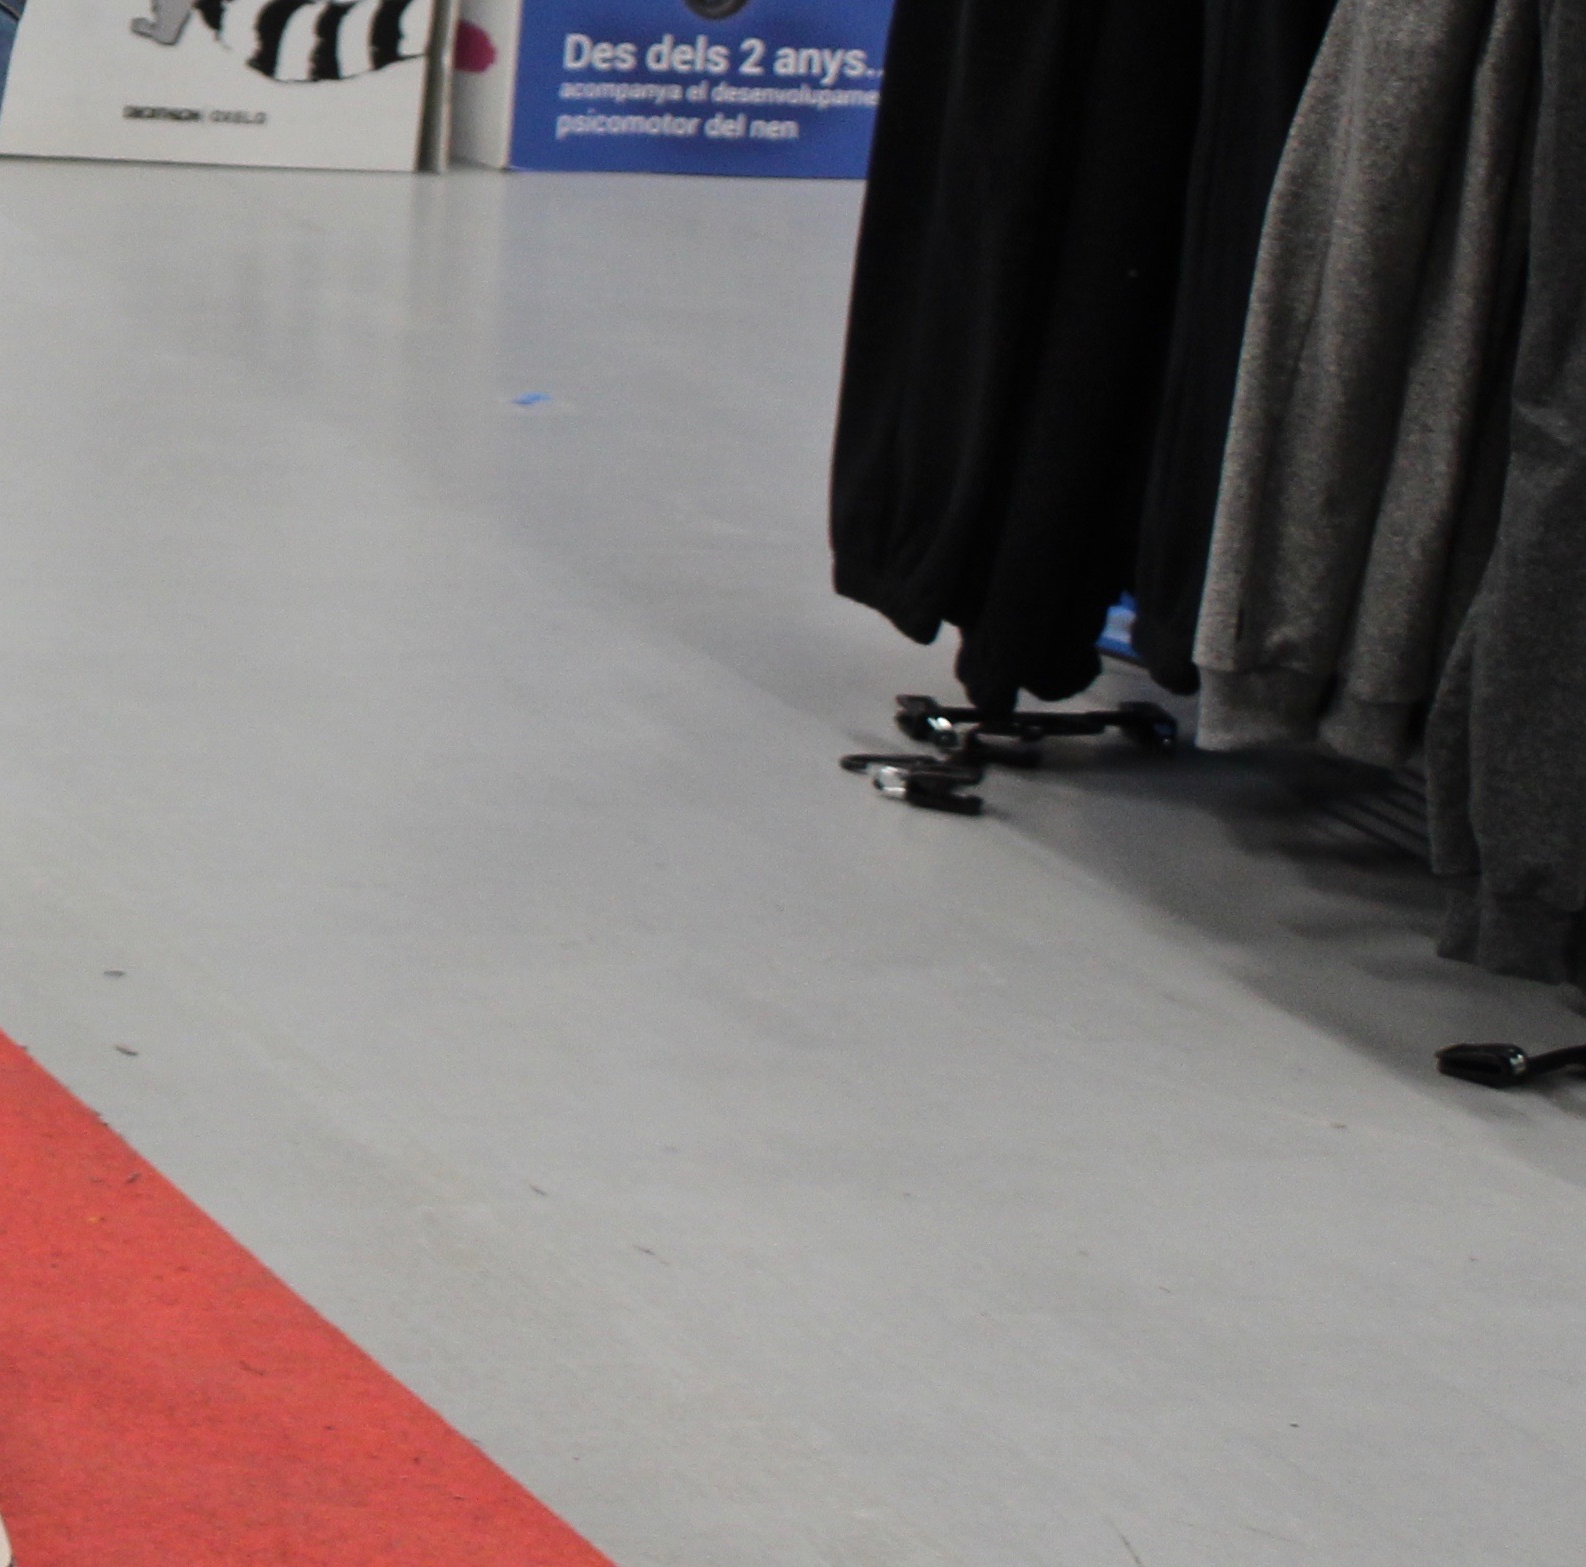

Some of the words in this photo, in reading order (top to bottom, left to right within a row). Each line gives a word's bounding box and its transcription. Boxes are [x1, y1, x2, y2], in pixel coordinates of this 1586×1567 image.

[562, 33, 637, 72] Des
[645, 34, 730, 74] dels
[738, 37, 765, 75] 2
[559, 82, 683, 104] acompanya
[686, 79, 709, 102] el
[711, 81, 880, 110] desenvolupame
[555, 113, 701, 141] psicomotor
[704, 112, 747, 139] del
[749, 119, 800, 140] nen
